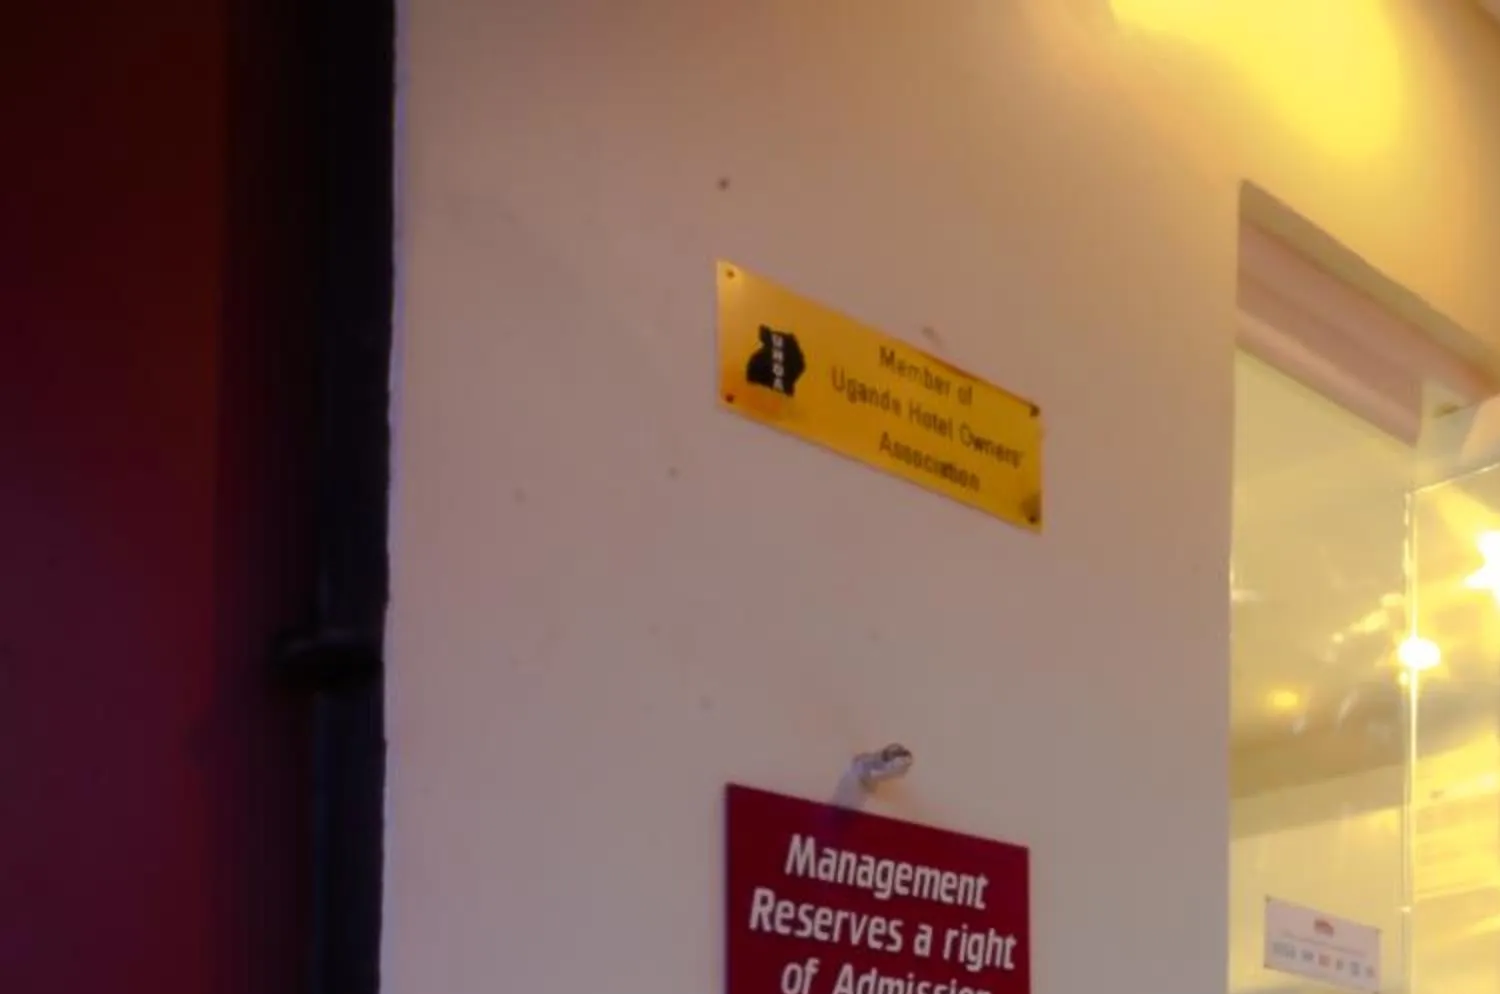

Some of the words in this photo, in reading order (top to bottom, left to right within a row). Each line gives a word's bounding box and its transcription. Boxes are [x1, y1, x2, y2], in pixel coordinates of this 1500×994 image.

[831, 365, 901, 417] Uganda
[909, 399, 953, 442] Hotel
[879, 345, 952, 396] Member
[958, 385, 973, 406] of
[879, 431, 981, 493] Association
[785, 833, 989, 910] Management
[749, 887, 903, 953] Reserves
[914, 923, 933, 957] a
[943, 923, 1017, 973] right
